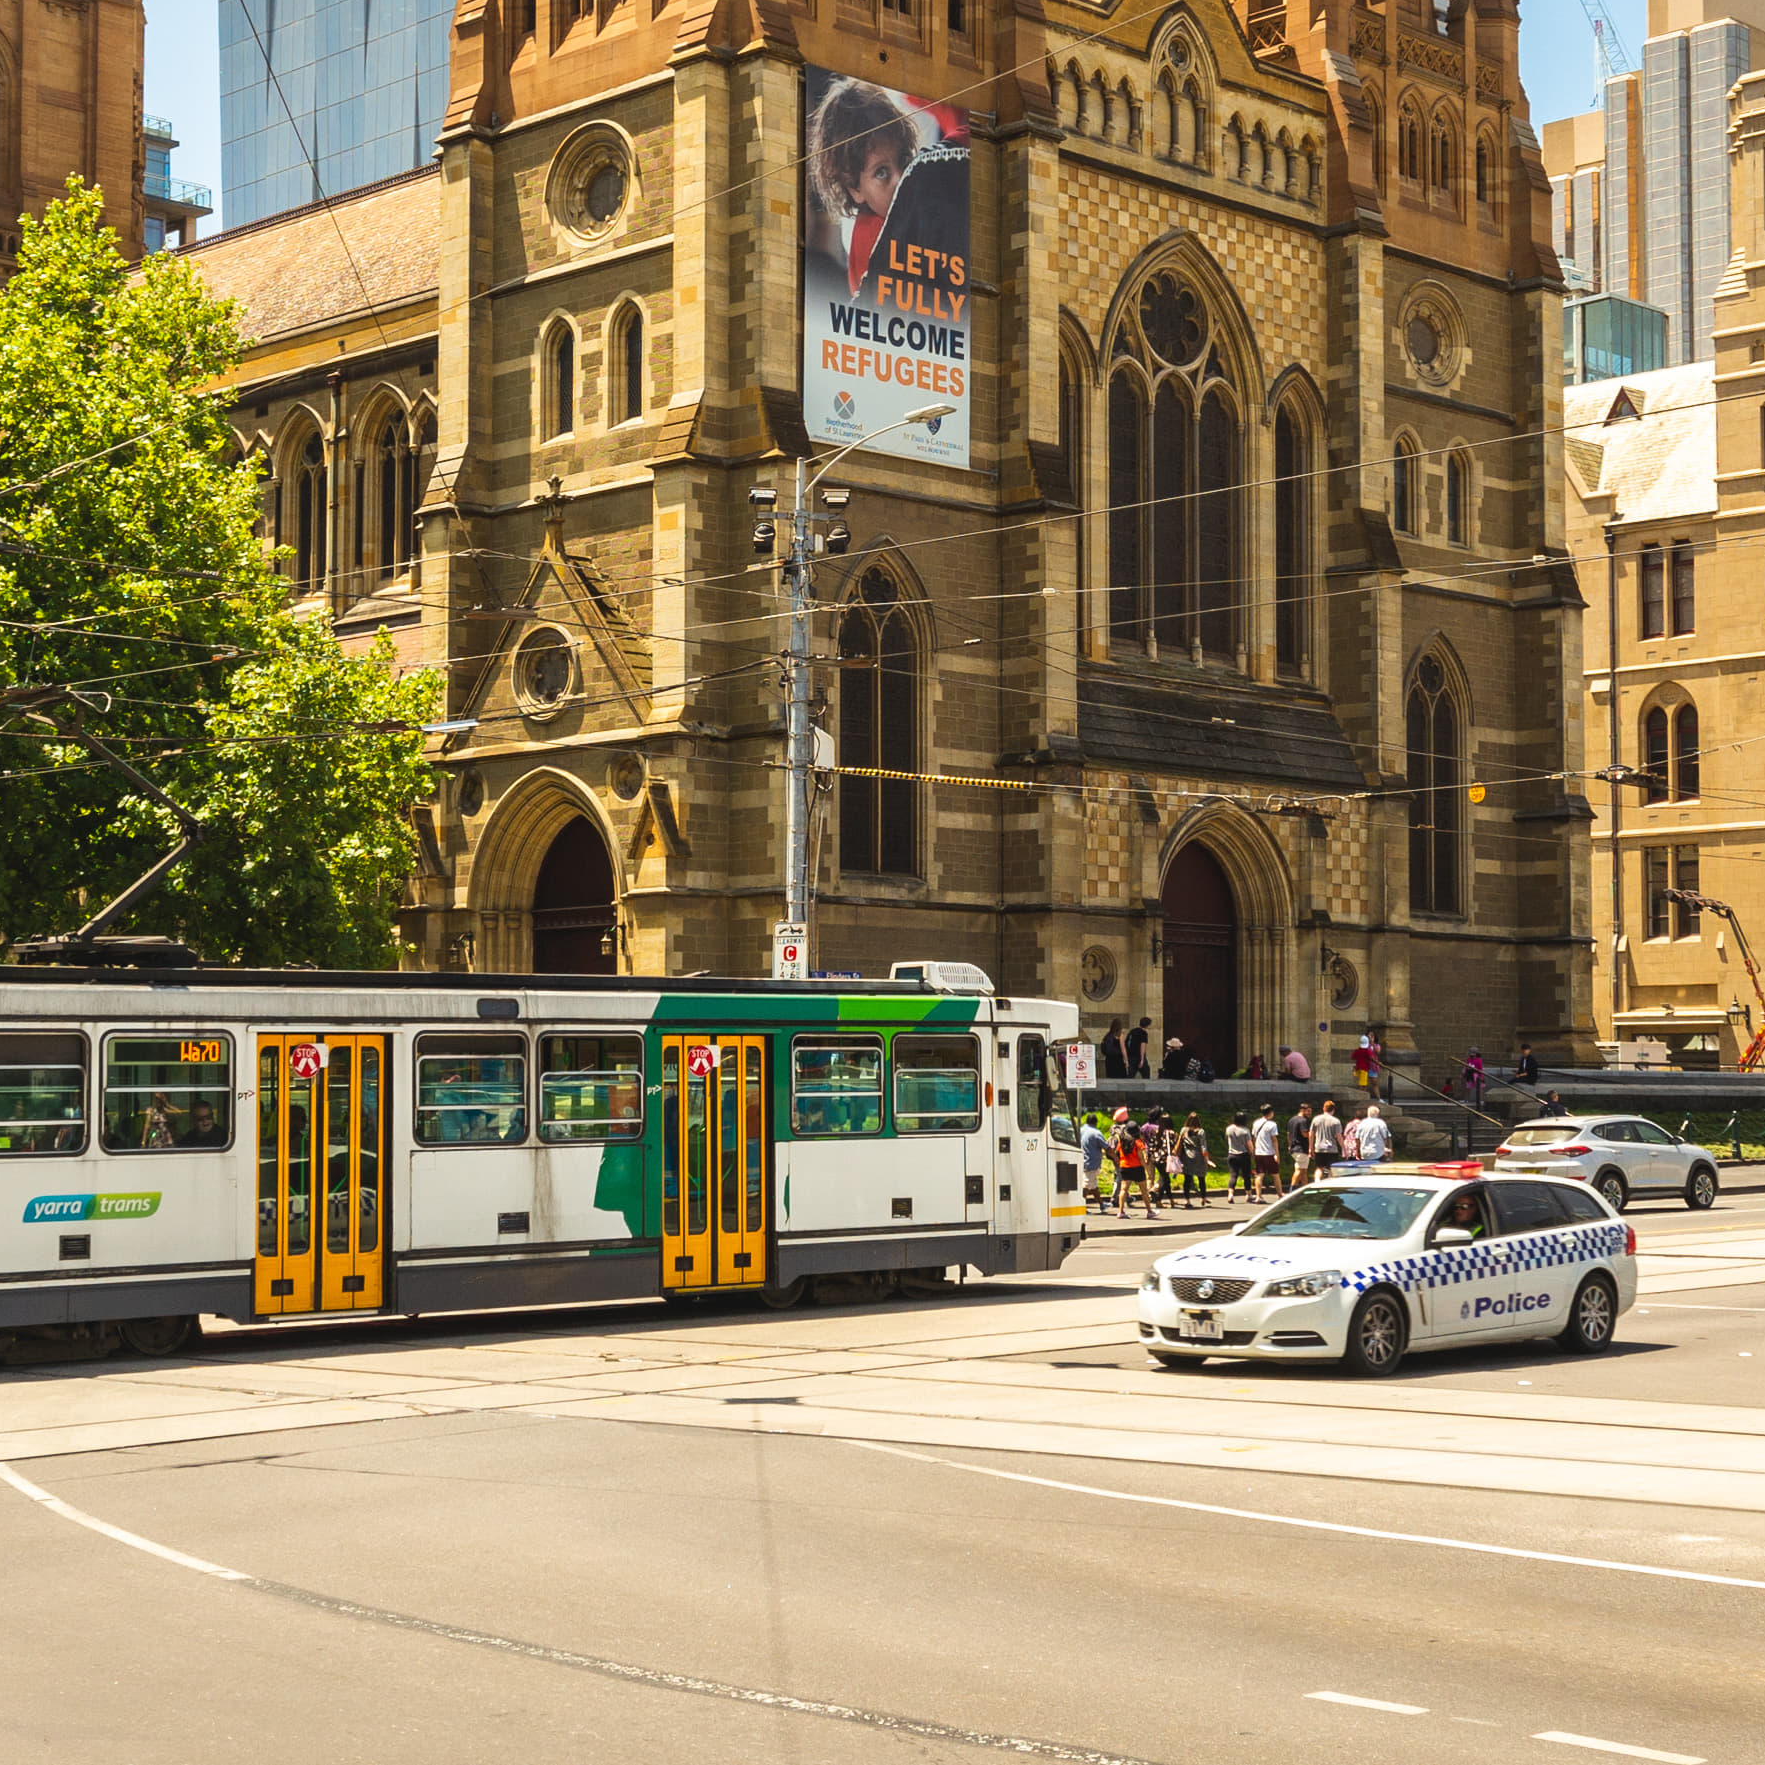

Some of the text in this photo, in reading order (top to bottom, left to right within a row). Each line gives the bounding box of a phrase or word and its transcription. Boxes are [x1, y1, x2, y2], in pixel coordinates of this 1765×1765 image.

[889, 239, 965, 286] LET'S
[877, 274, 966, 323] FULLY
[829, 302, 965, 360] WELCOME
[822, 339, 965, 397] REFUGEES
[180, 1040, 220, 1063] Wa70
[296, 1047, 317, 1058] STOP
[691, 1049, 710, 1058] STOP
[1026, 1139, 1038, 1152] 267
[34, 1197, 151, 1219] yarra trams
[1474, 1292, 1551, 1318] Police
